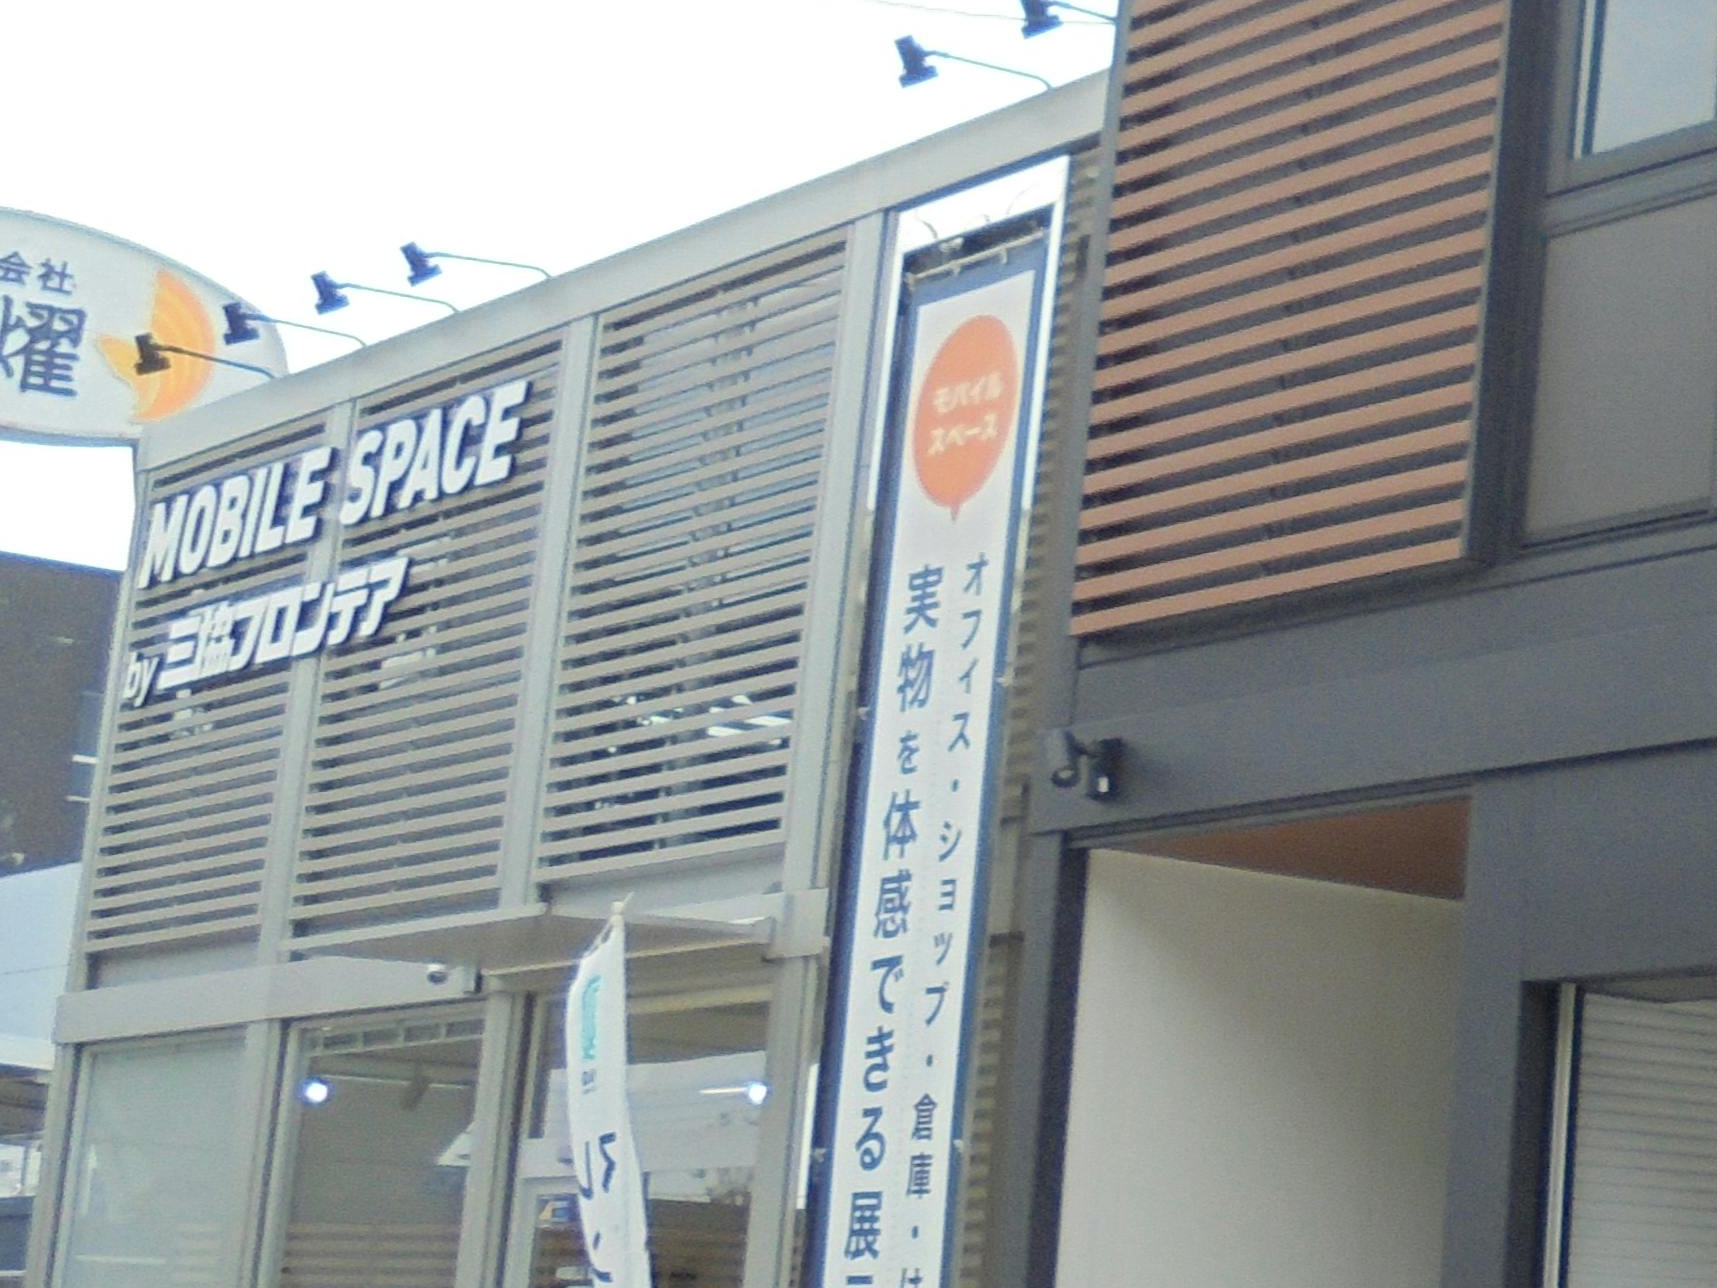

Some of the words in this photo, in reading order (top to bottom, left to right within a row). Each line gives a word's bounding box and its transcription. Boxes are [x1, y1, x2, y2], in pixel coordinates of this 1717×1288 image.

[933, 371, 1003, 413] モバイル
[927, 413, 999, 456] スペース
[139, 446, 336, 589] MOBILE
[339, 381, 530, 526] SPACE
[123, 651, 158, 708] by
